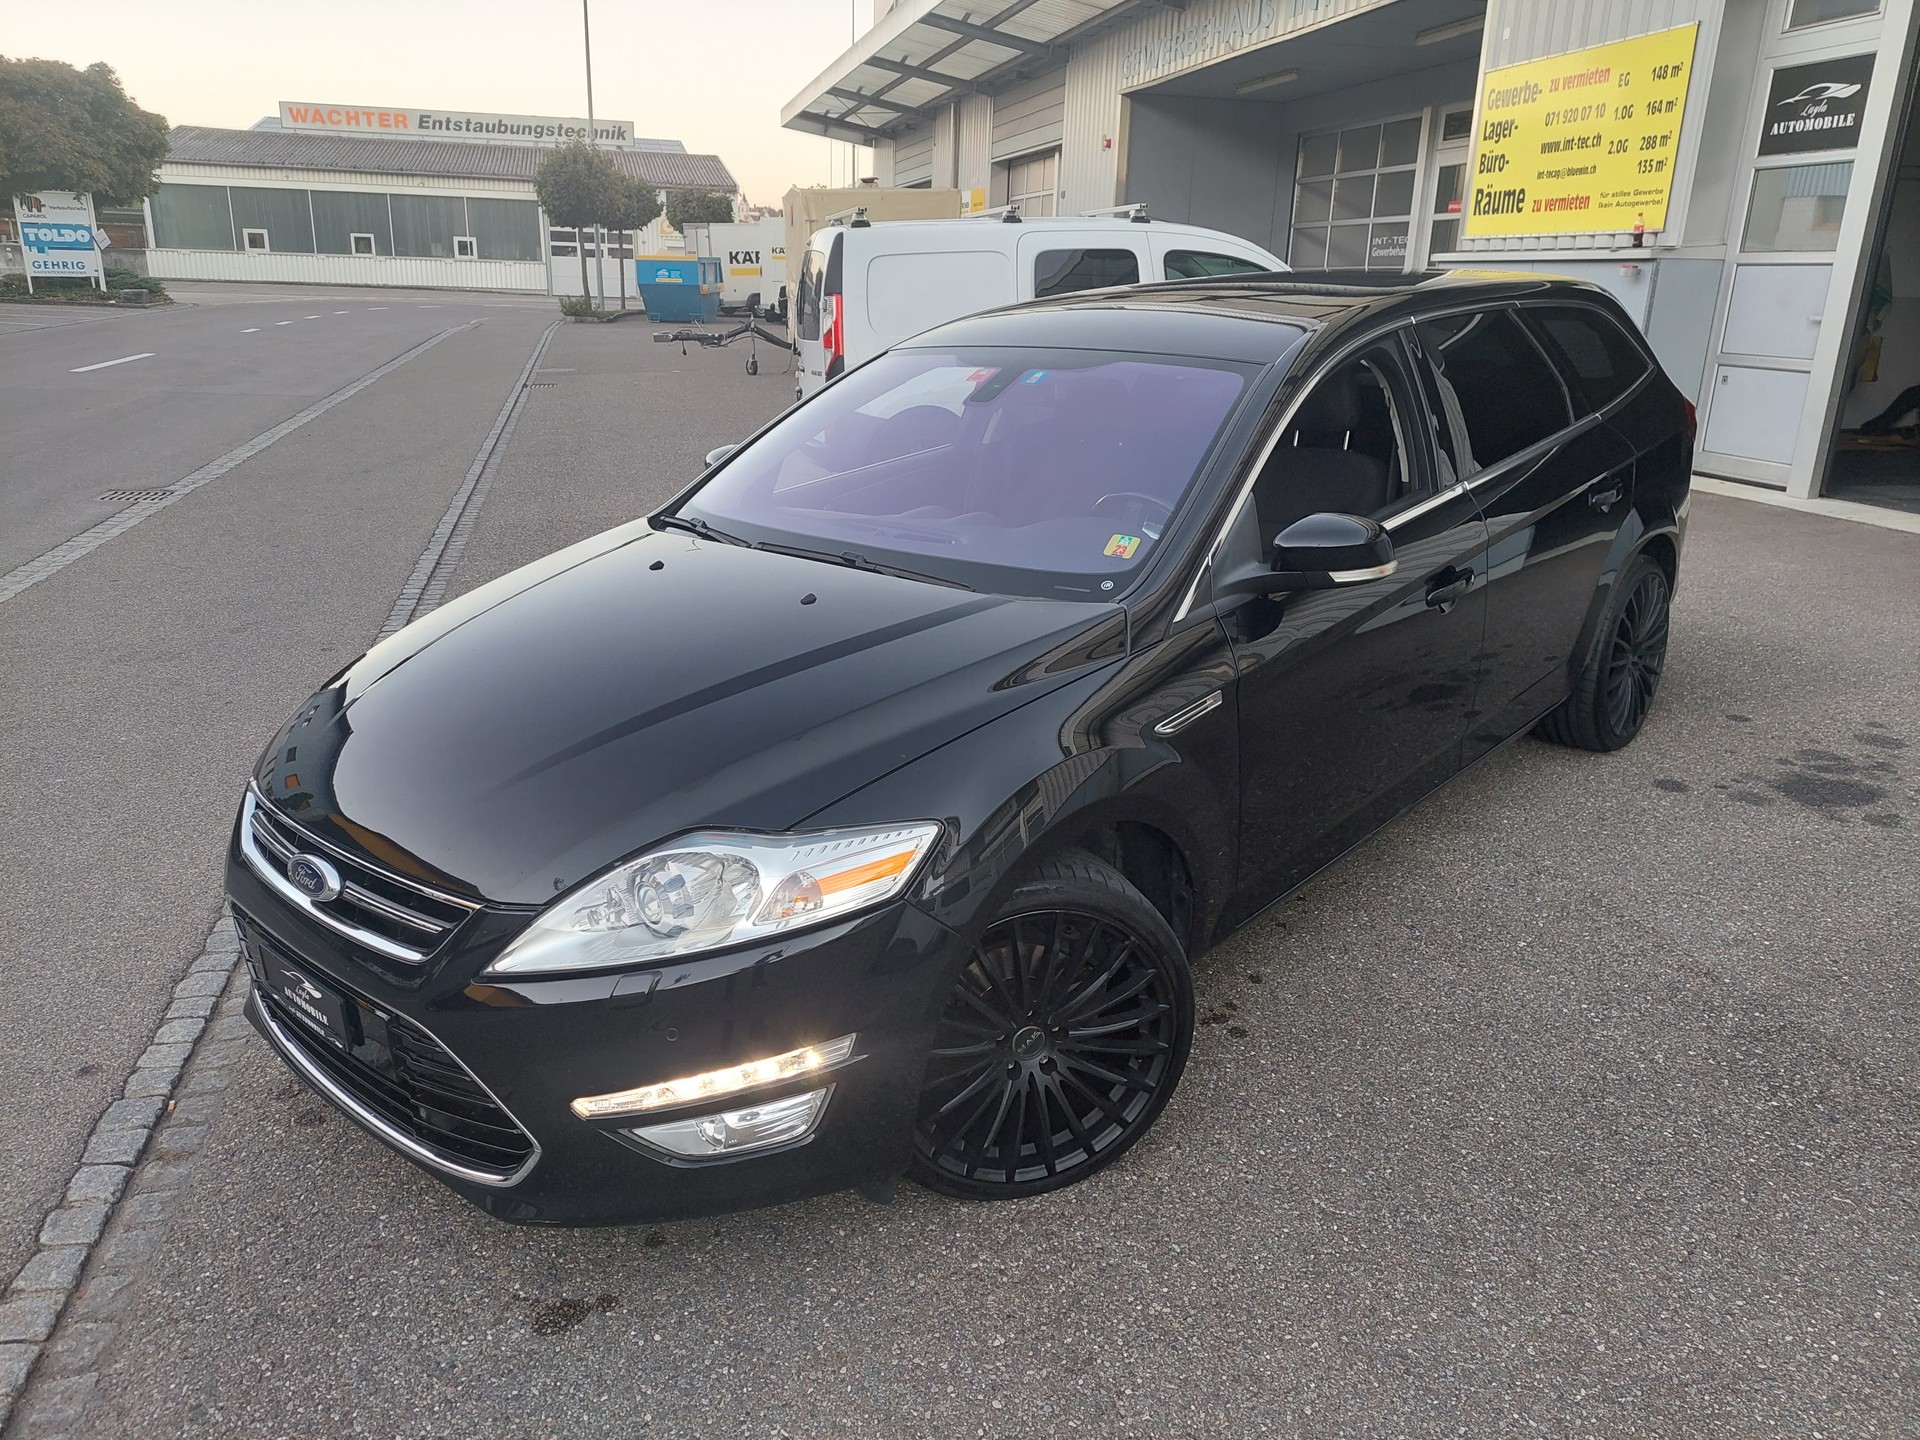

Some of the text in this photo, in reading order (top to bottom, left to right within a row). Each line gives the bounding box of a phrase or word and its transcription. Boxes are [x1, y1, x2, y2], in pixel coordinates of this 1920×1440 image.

[1121, 0, 1275, 80] GEWERBEHAUS
[1549, 77, 1560, 93] zu
[1562, 67, 1611, 90] vermieten
[1617, 72, 1631, 88] EG
[1651, 64, 1669, 82] 148
[1487, 80, 1543, 111] Gewerbe-
[1545, 110, 1561, 127] 071
[1562, 107, 1579, 124] 920
[1580, 104, 1592, 121] 07
[1595, 102, 1606, 119] 10
[1646, 99, 1664, 116] 164
[1801, 99, 1828, 118] Layla
[288, 106, 627, 141] WACHTER Entstaubungstechnik
[1483, 118, 1519, 144] Lager-
[1770, 113, 1856, 136] AUTOMOBILE
[1540, 131, 1602, 155] www.int-tec.ch
[1639, 135, 1658, 151] 288
[1479, 150, 1510, 175] Büro-
[1536, 163, 1597, 180] int-tecag@bluewin.ch
[1637, 159, 1654, 174] 135
[1473, 183, 1526, 216] Räume
[1531, 193, 1591, 213] zu vermieten
[1600, 187, 1664, 199] für stilles Gewerbe
[1615, 198, 1664, 208] Autogewerbe)
[48, 204, 87, 212] Verkaufsstelle
[23, 228, 91, 243] TOLDO
[32, 260, 86, 270] GEHRIG
[1112, 545, 1127, 555] 23
[297, 864, 318, 889] Ford
[284, 986, 329, 1026] AUTOMOBILE
